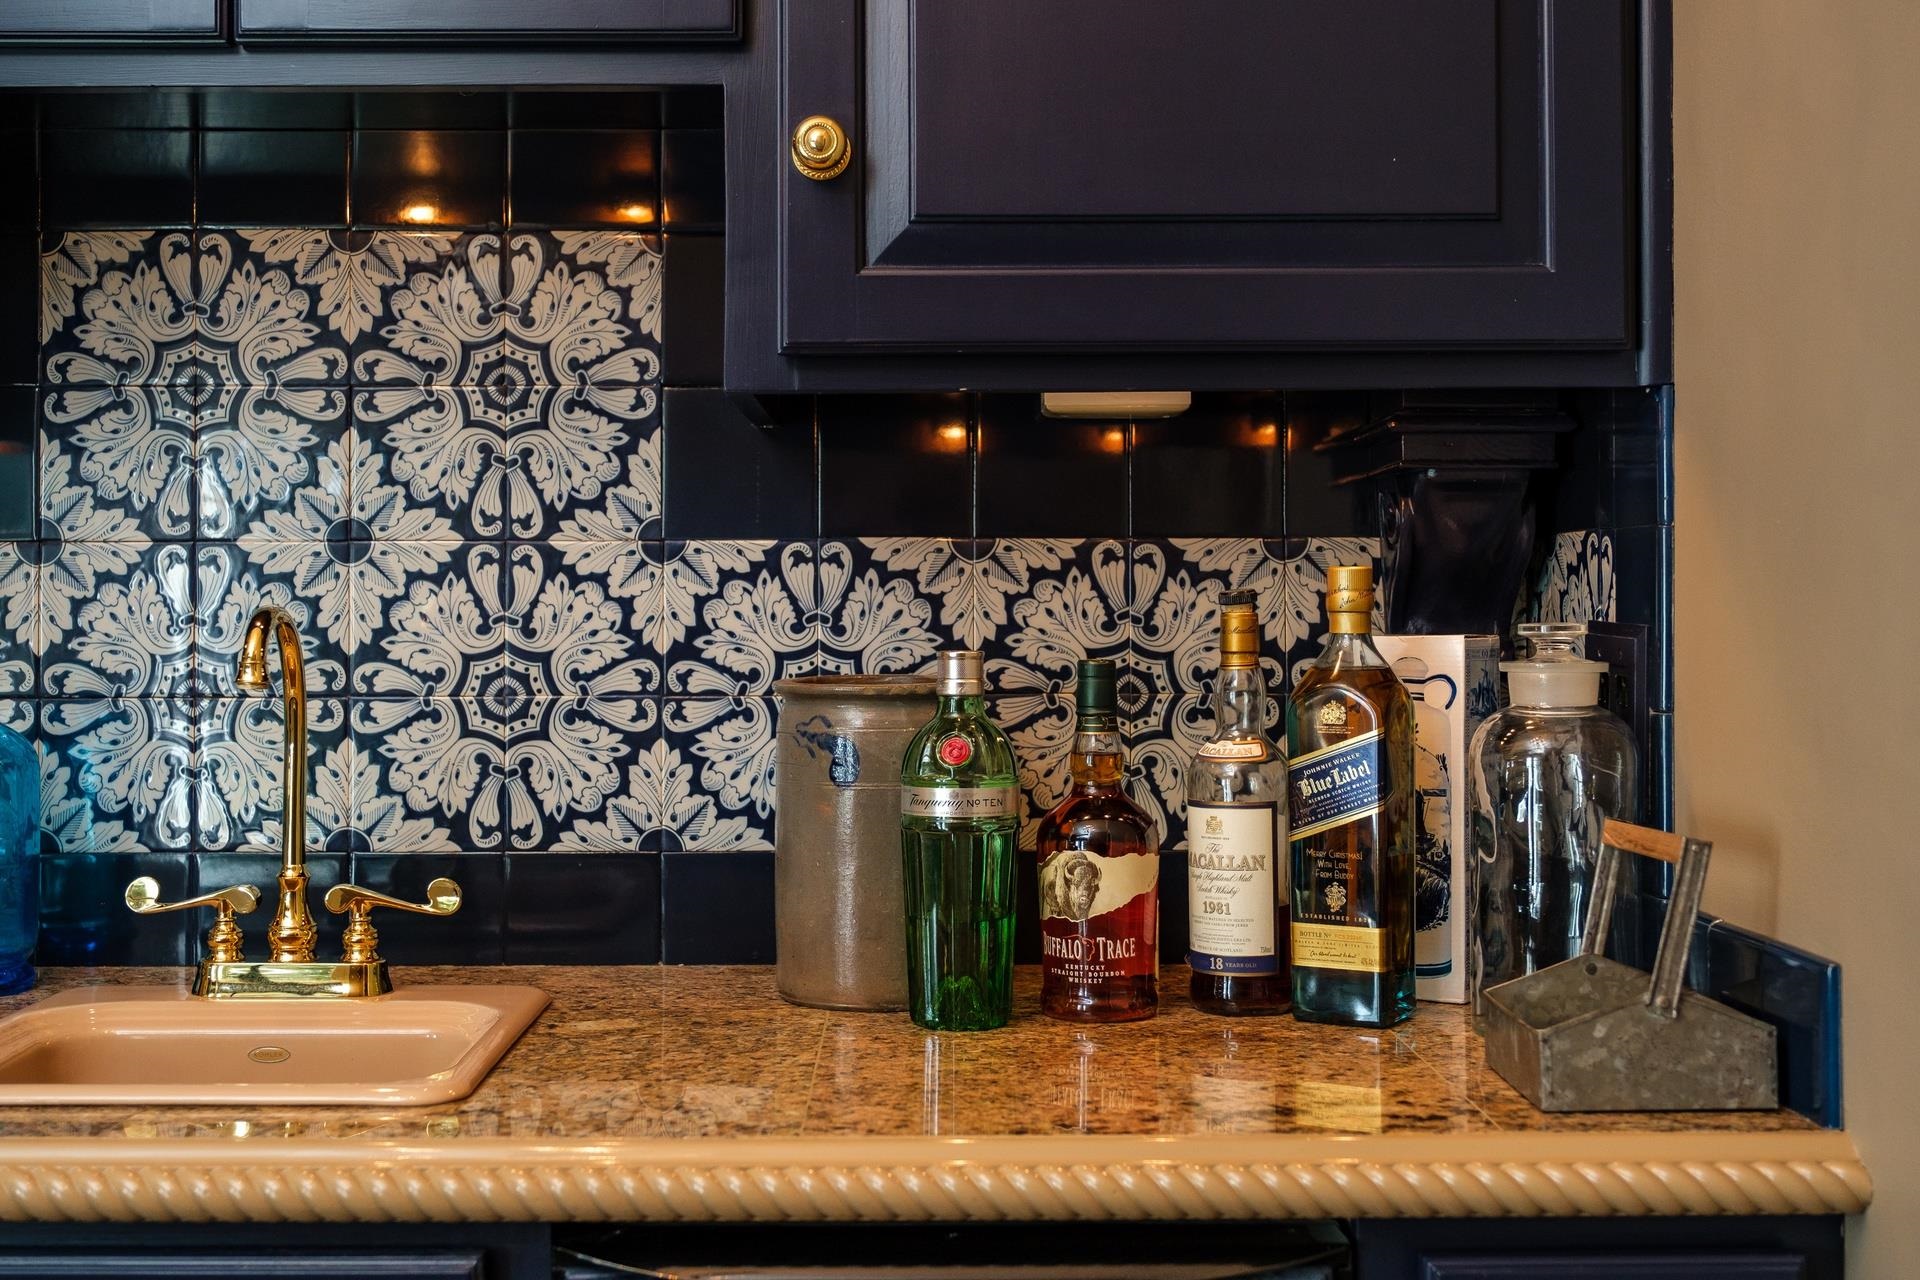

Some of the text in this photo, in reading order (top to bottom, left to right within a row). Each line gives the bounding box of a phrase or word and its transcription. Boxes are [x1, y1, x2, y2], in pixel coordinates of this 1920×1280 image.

[1303, 752, 1360, 778] JOHNNIE WALKER
[1297, 759, 1372, 800] Blue Label
[910, 793, 963, 811] Tanqueray
[983, 798, 1004, 807] TEN
[1305, 848, 1363, 861] MERRY CHRISTMAS!
[1317, 859, 1333, 869] WITH
[1315, 868, 1355, 880] FROM BUDDY
[1202, 900, 1232, 916] 1981
[1300, 912, 1351, 923] ESTABLISHED
[1299, 930, 1322, 939] BOTTLE
[1043, 931, 1136, 961] BUFFALO TRACE
[1065, 963, 1105, 972] KENTUCKY
[1209, 957, 1224, 970] 18
[1051, 967, 1126, 978] STRAIGHT BOURBON
[1068, 976, 1103, 985] WHISKEY
